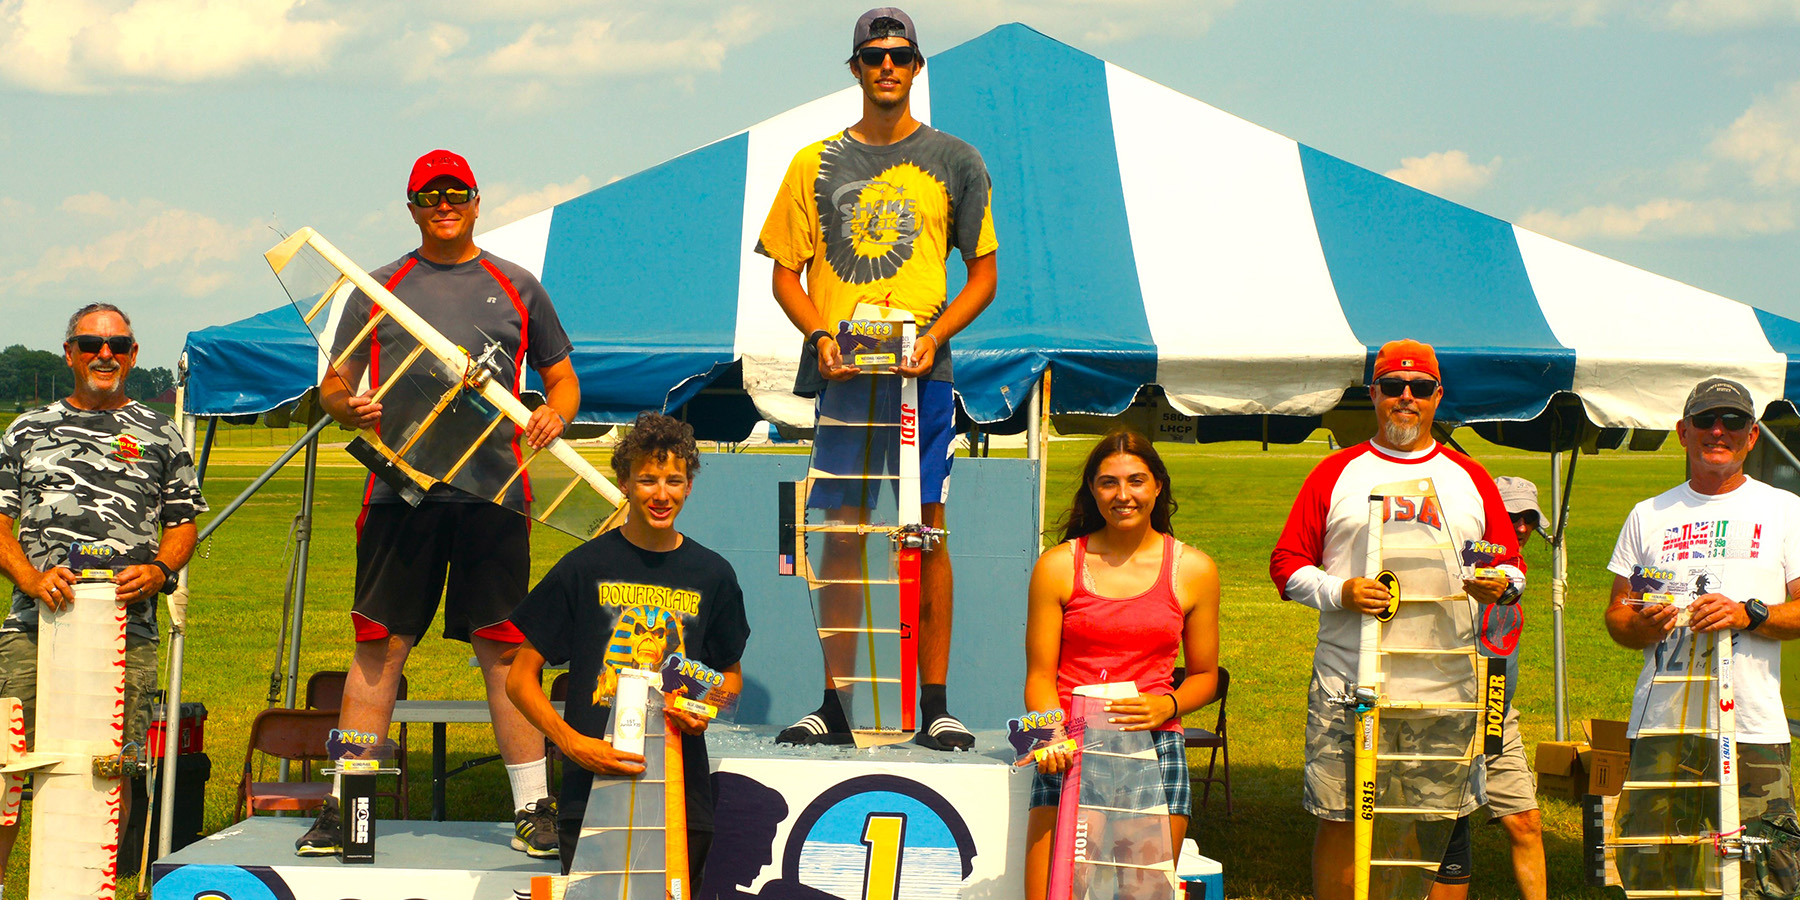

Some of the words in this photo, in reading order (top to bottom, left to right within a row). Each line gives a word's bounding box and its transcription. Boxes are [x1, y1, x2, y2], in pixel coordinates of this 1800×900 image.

[840, 199, 917, 221] SHAKE
[851, 321, 890, 336] Nats
[900, 403, 916, 447] JEDI
[1160, 425, 1192, 434] LHCP
[80, 544, 110, 556] Nats
[1473, 541, 1503, 554] Nats
[1642, 567, 1674, 580] Nats
[600, 584, 700, 615] POWERSLAVE
[679, 660, 721, 685] Nats
[1486, 674, 1506, 738] DOZER
[1719, 698, 1735, 712] 3
[1021, 711, 1062, 733] Nats
[341, 731, 376, 744] Nats
[1722, 760, 1731, 775] USA
[1361, 780, 1375, 821] 63815
